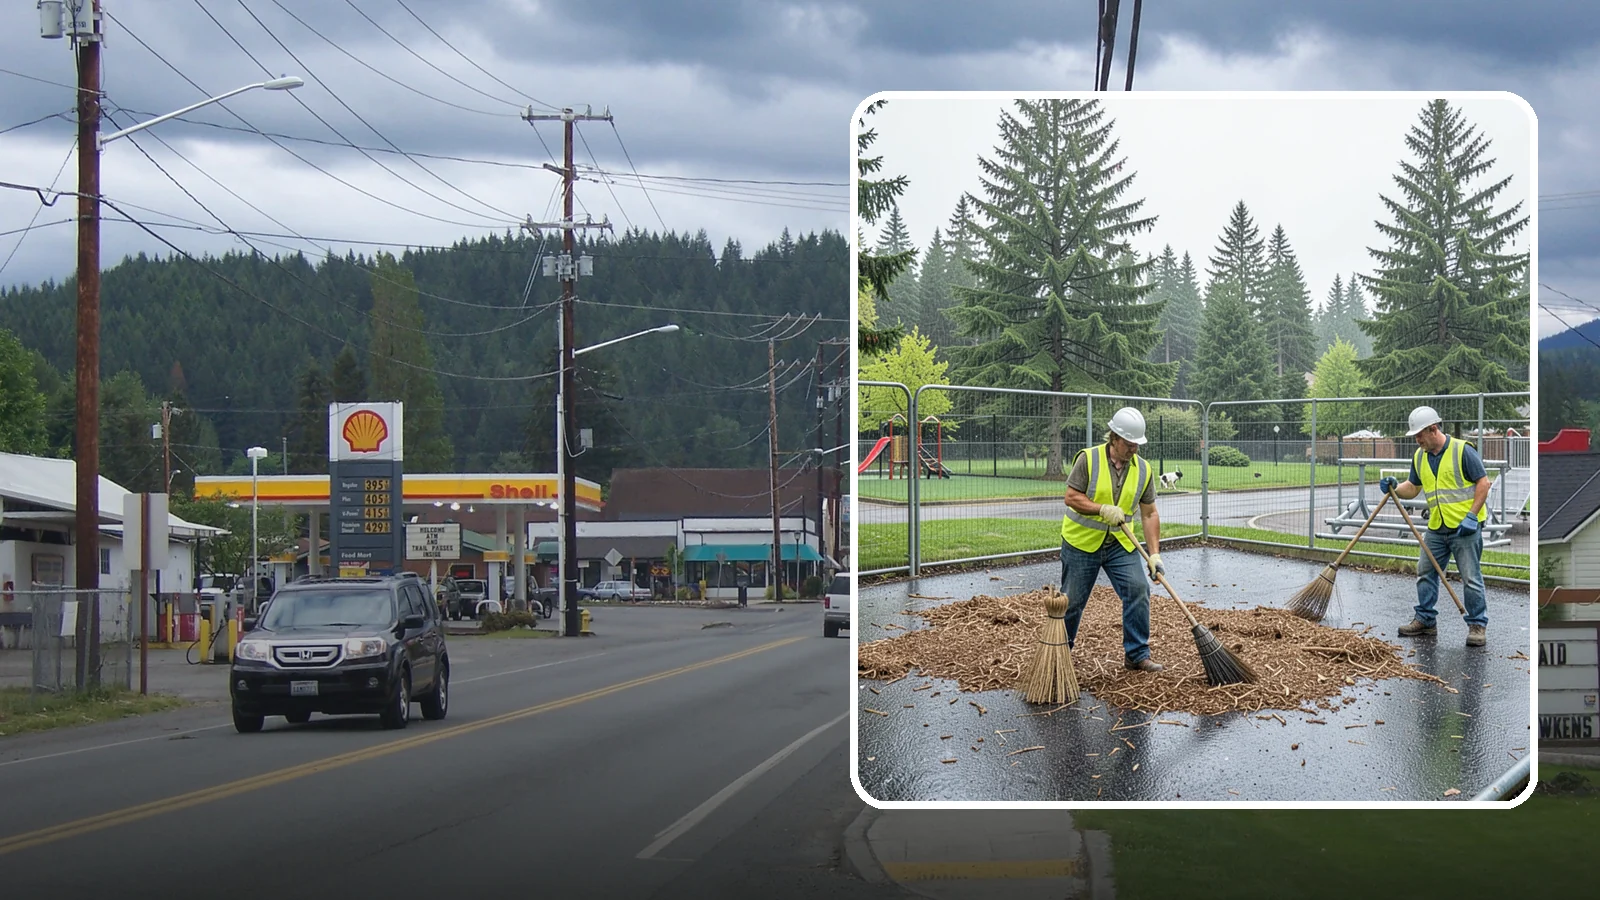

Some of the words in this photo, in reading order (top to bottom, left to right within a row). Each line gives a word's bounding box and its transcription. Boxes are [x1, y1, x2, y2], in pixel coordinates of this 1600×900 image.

[366, 480, 383, 490] 395
[490, 484, 547, 499] Shell
[366, 494, 383, 504] 405
[366, 508, 383, 518] 415
[366, 522, 383, 532] 429
[1539, 643, 1566, 665] AID
